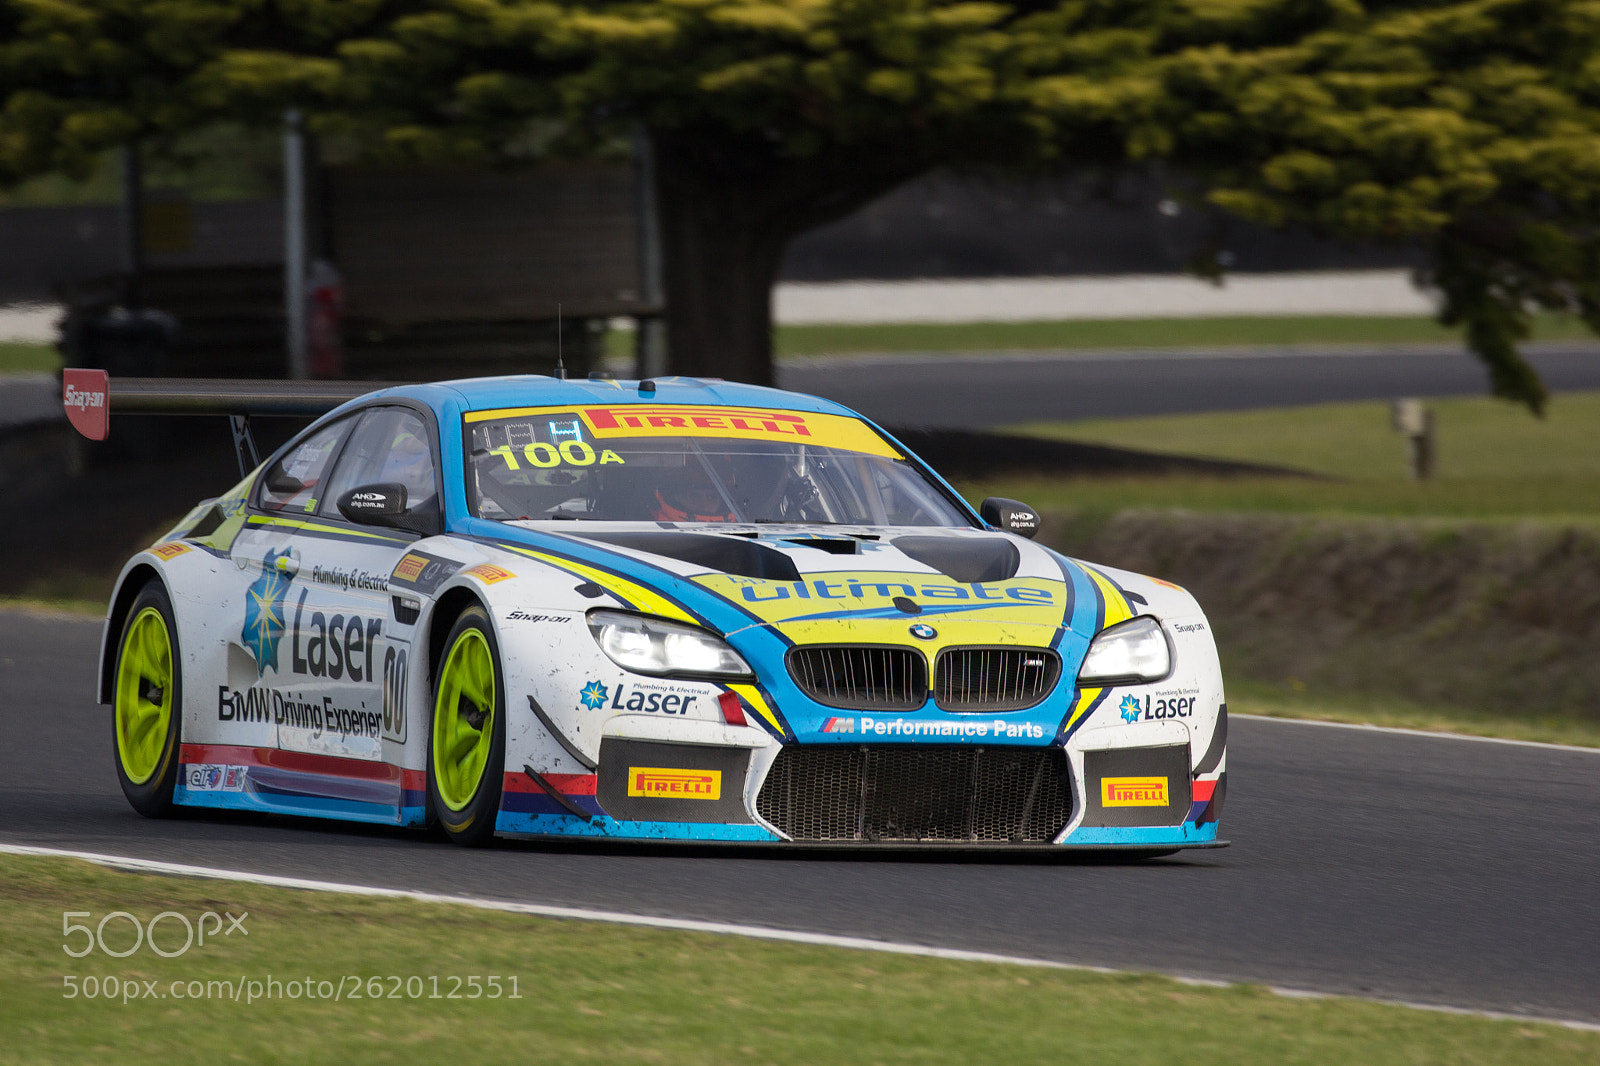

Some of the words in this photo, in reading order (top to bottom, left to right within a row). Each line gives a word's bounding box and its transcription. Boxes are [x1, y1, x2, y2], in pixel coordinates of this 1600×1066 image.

[584, 408, 812, 437] PIRELLI
[312, 564, 348, 592] Plumbing
[349, 568, 358, 589] &
[740, 578, 1054, 606] ultimate
[506, 611, 571, 623] Snap-on
[293, 586, 382, 683] Laser
[611, 683, 697, 715] Laser
[633, 682, 667, 692] Plumbing
[676, 687, 710, 696] Electrical
[218, 685, 270, 723] BMW
[272, 688, 323, 740] Driving
[1145, 694, 1196, 720] Laser
[860, 717, 988, 736] Performance
[993, 720, 1044, 738] Parts
[636, 774, 713, 794] PIRELLI
[1108, 783, 1163, 801] PIRELLI
